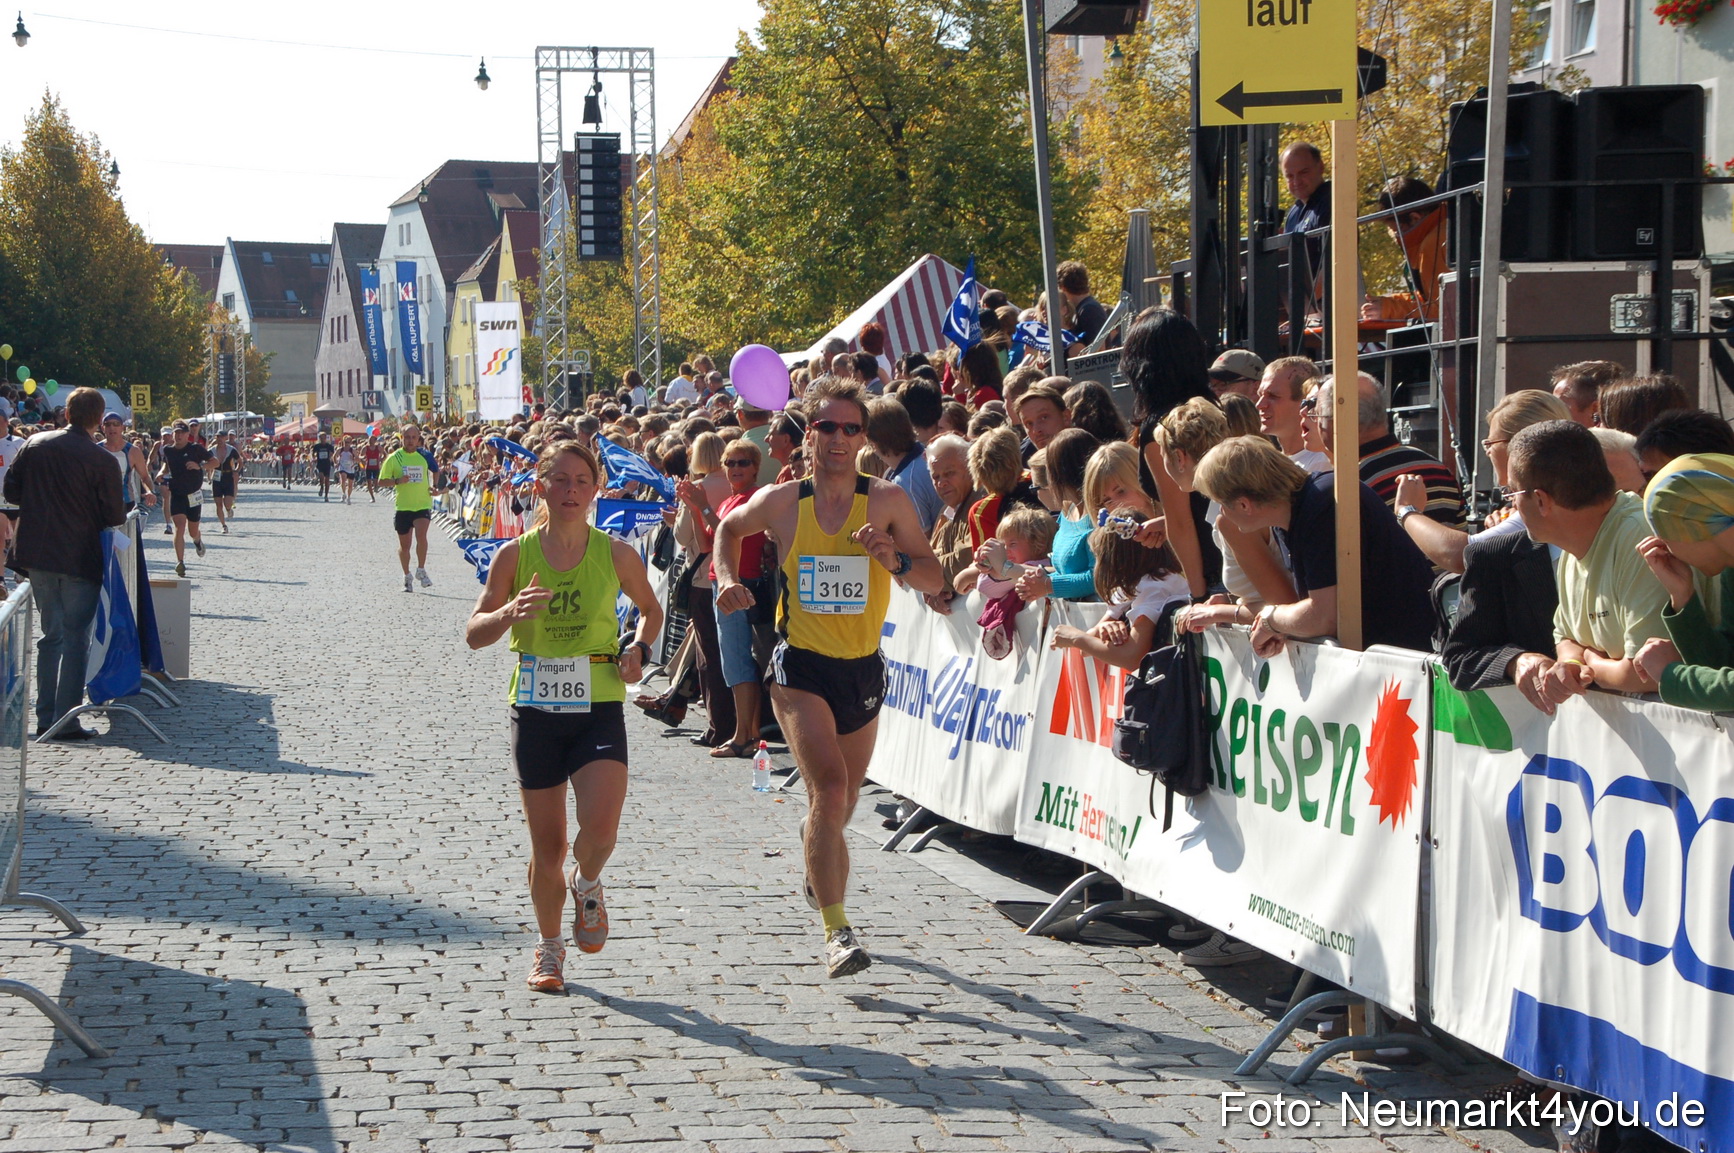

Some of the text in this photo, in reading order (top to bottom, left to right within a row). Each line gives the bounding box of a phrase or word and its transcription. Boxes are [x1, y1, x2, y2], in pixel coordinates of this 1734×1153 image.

[1248, 0, 1312, 26] lauf
[407, 304, 417, 345] RUPPERT
[479, 320, 518, 331] swn
[136, 393, 146, 407] B
[419, 393, 429, 406] B
[333, 426, 340, 435] C
[818, 561, 840, 573] Sven
[801, 578, 806, 587] A
[820, 581, 864, 598] 3162
[551, 624, 588, 633] INTERSPORT
[537, 661, 576, 675] Irmgard
[521, 677, 526, 686] A
[538, 681, 585, 698] 3186
[1203, 656, 1361, 836] Reisen
[1034, 781, 1079, 832] Mit
[1248, 893, 1355, 957] www.merz-reisen.com
